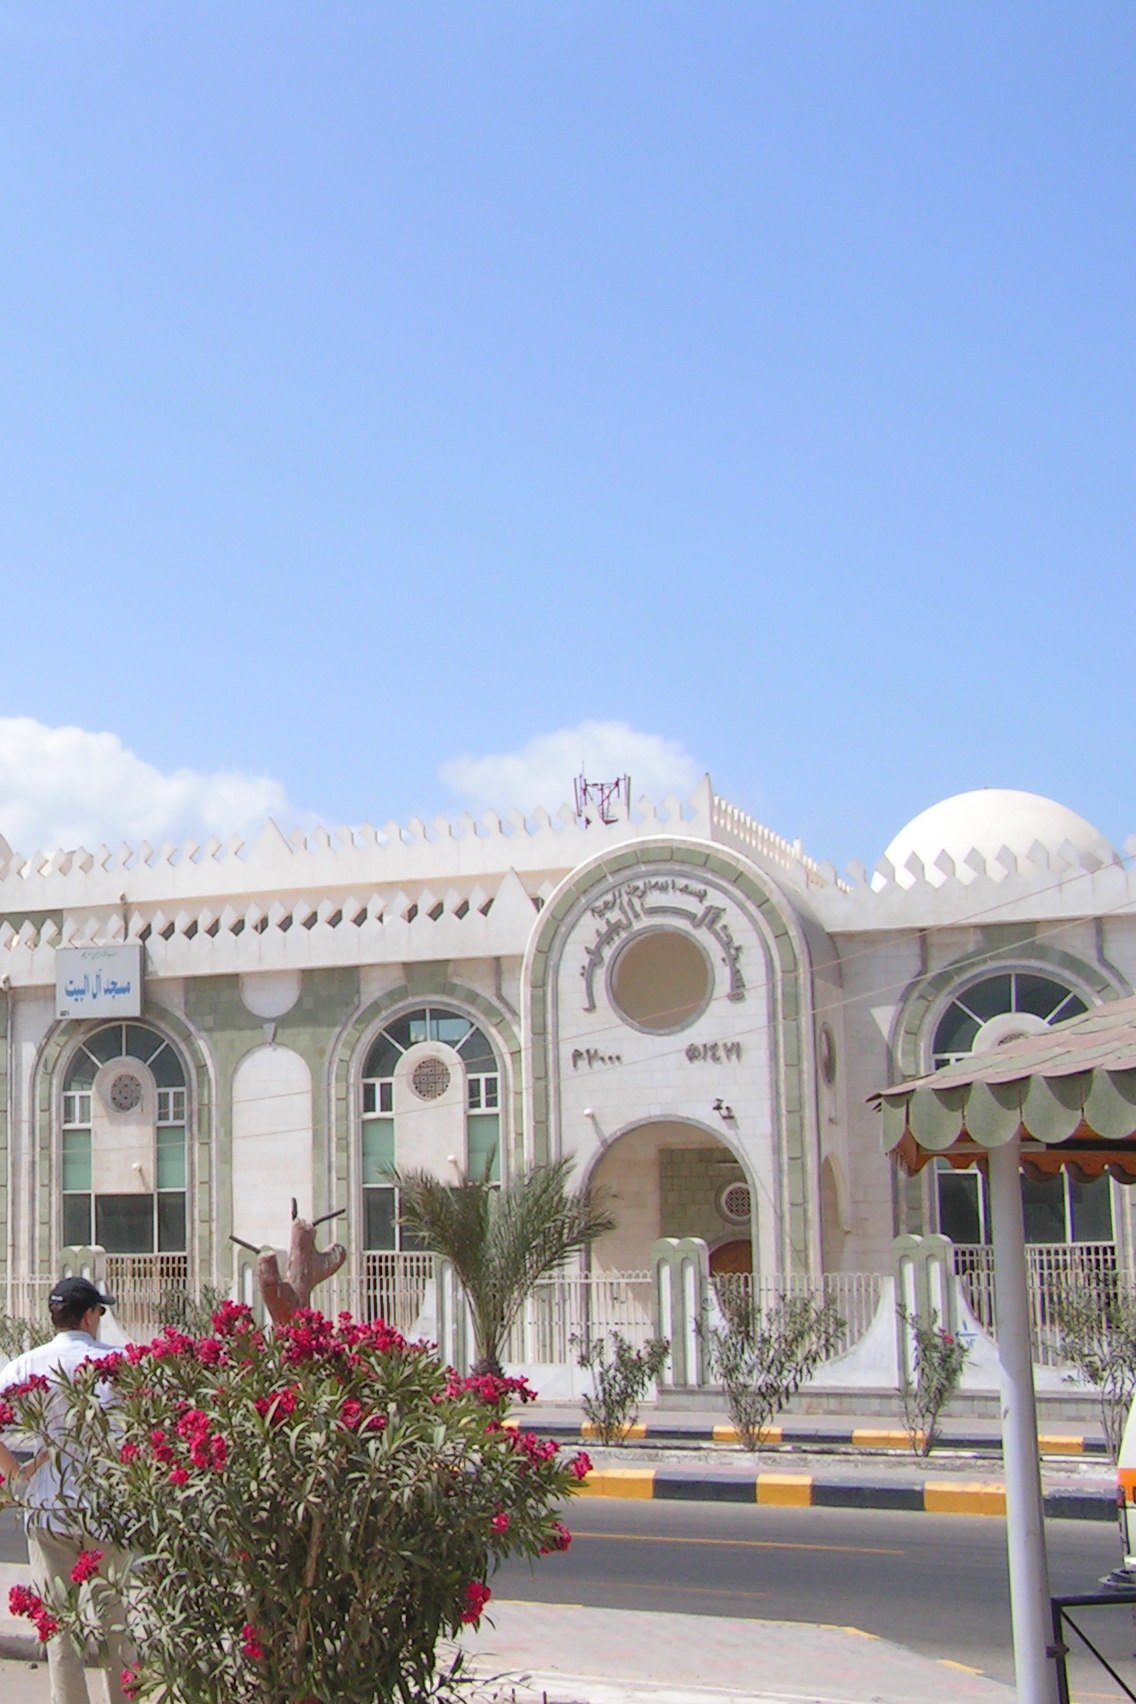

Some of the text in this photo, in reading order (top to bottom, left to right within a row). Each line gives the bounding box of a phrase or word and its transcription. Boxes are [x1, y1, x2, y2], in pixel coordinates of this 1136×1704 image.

[577, 895, 641, 1014] البيت
[64, 972, 90, 1002] البيت
[104, 981, 131, 999] مسجد
